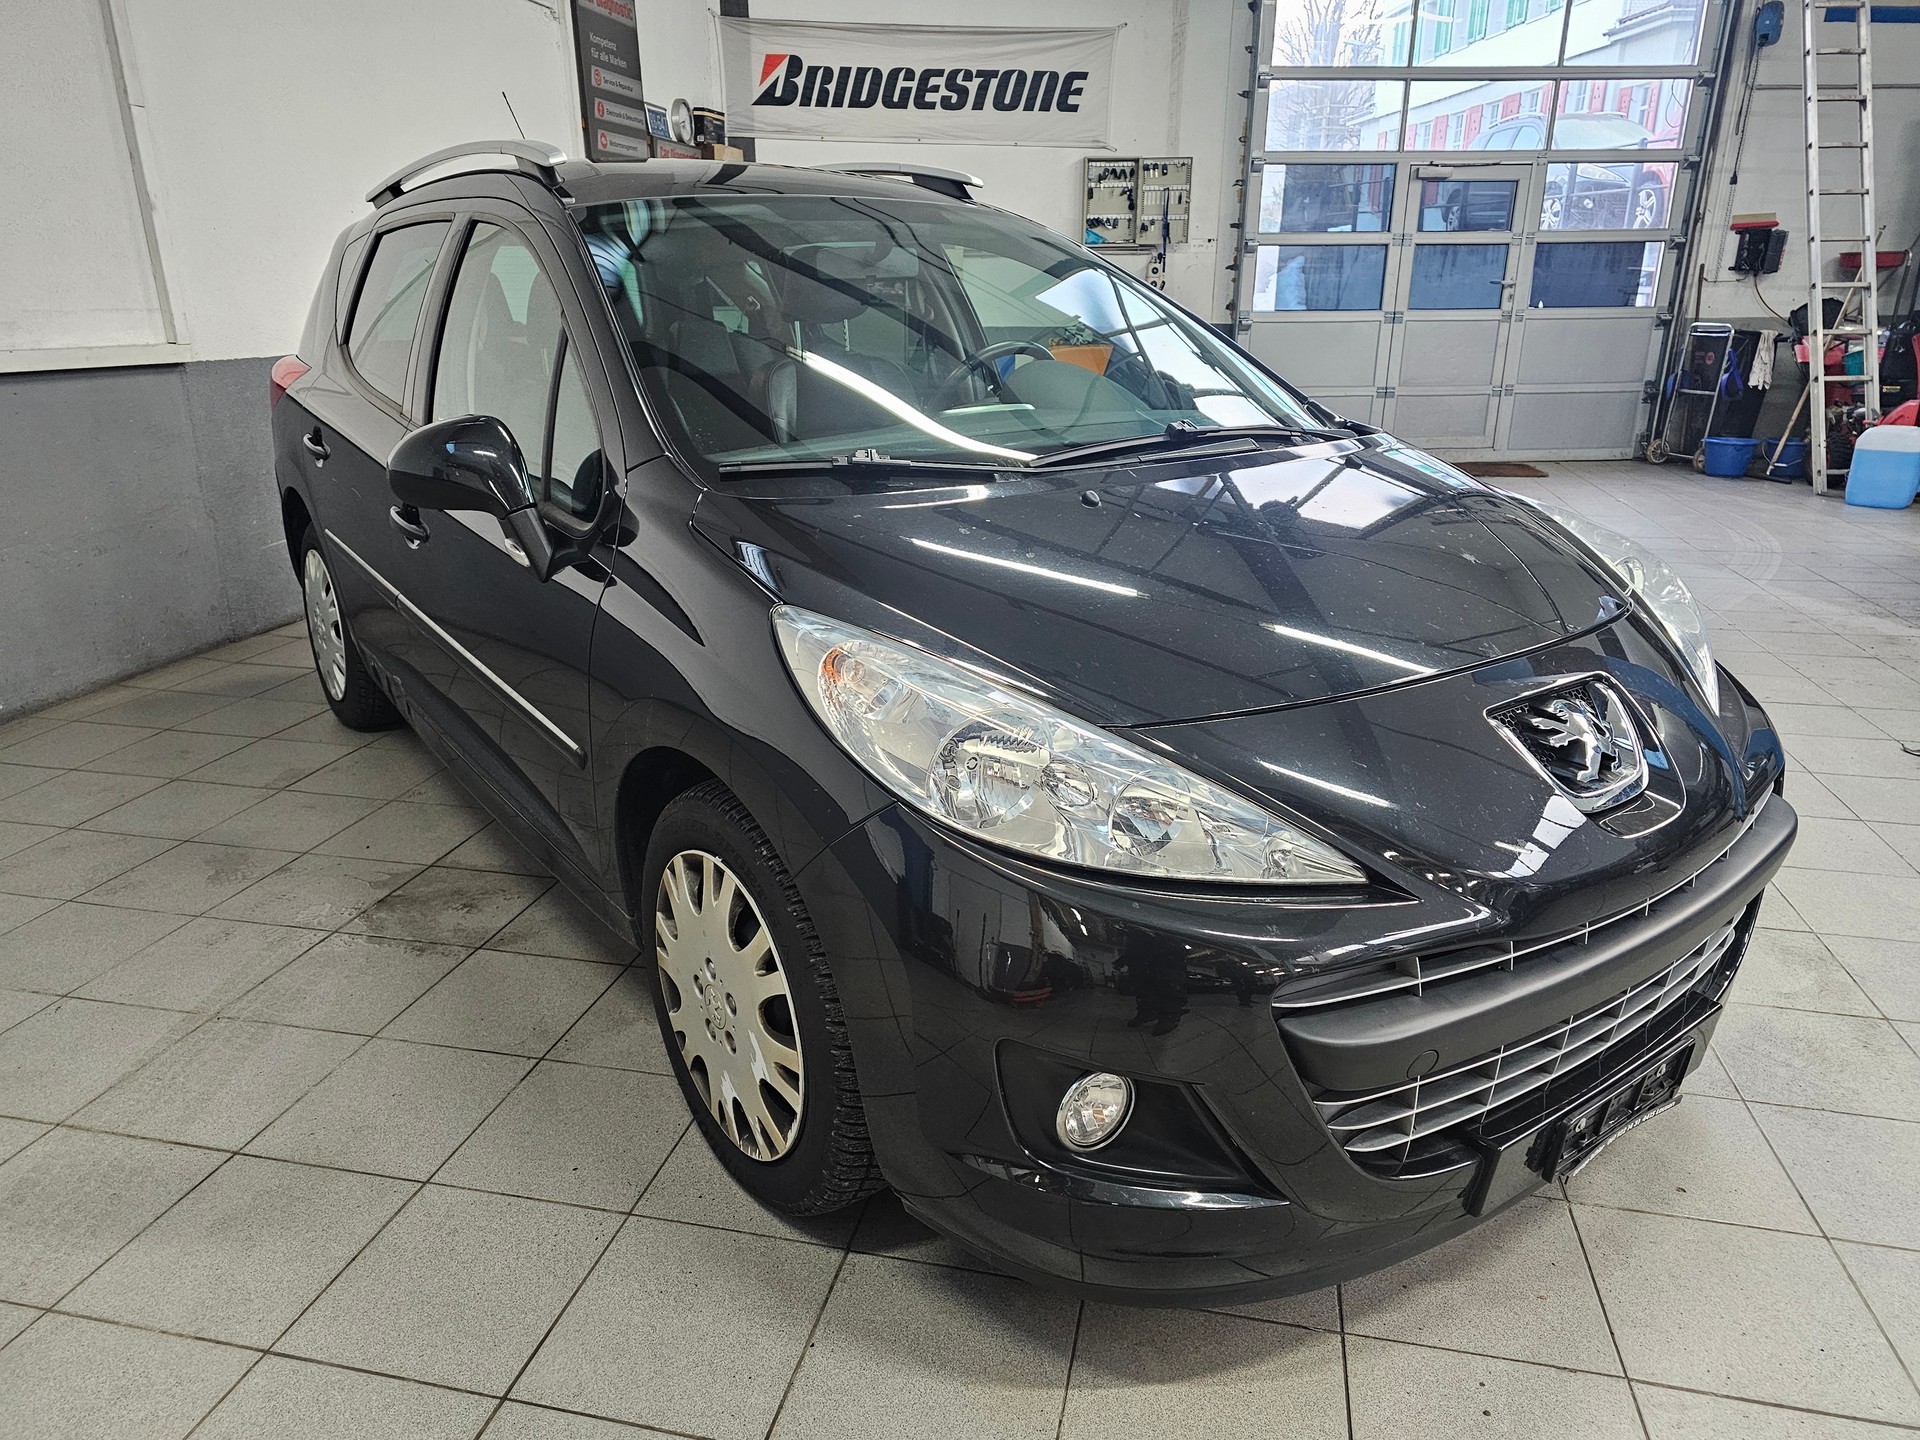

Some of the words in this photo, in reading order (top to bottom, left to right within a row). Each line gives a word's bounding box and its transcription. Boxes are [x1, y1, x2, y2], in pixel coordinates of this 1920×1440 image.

[589, 31, 617, 51] Kompetenz
[591, 47, 599, 59] für
[600, 51, 609, 62] alle
[610, 54, 628, 69] Marken
[603, 76, 616, 87] Service
[751, 54, 1089, 113] BRIDGESTONE
